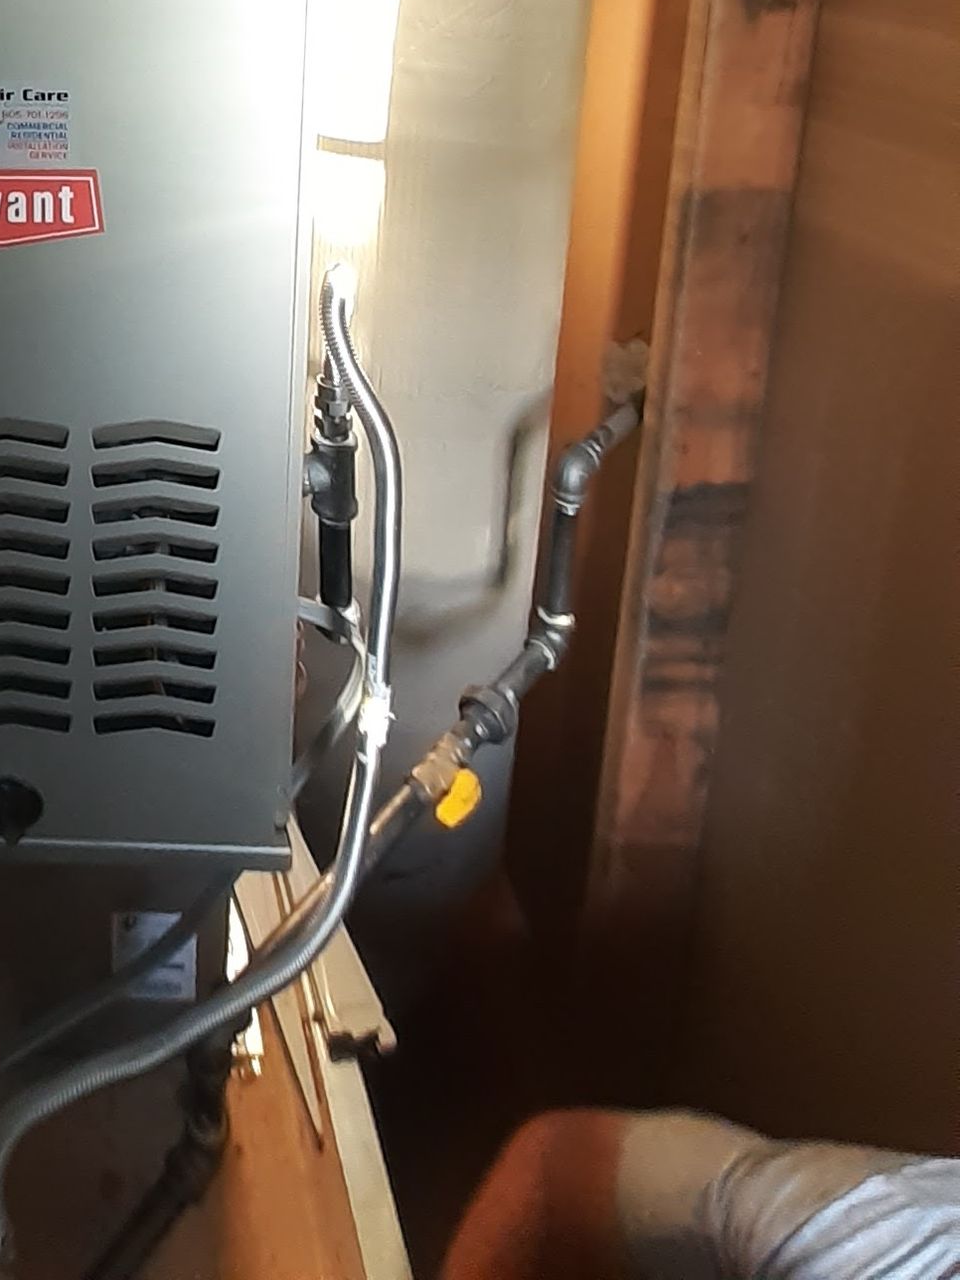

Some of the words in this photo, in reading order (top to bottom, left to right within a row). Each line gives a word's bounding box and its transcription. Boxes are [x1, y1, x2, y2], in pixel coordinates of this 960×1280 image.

[22, 88, 69, 102] Care
[7, 122, 68, 130] COMMERCIAL
[10, 131, 67, 139] RESIDENTIAL
